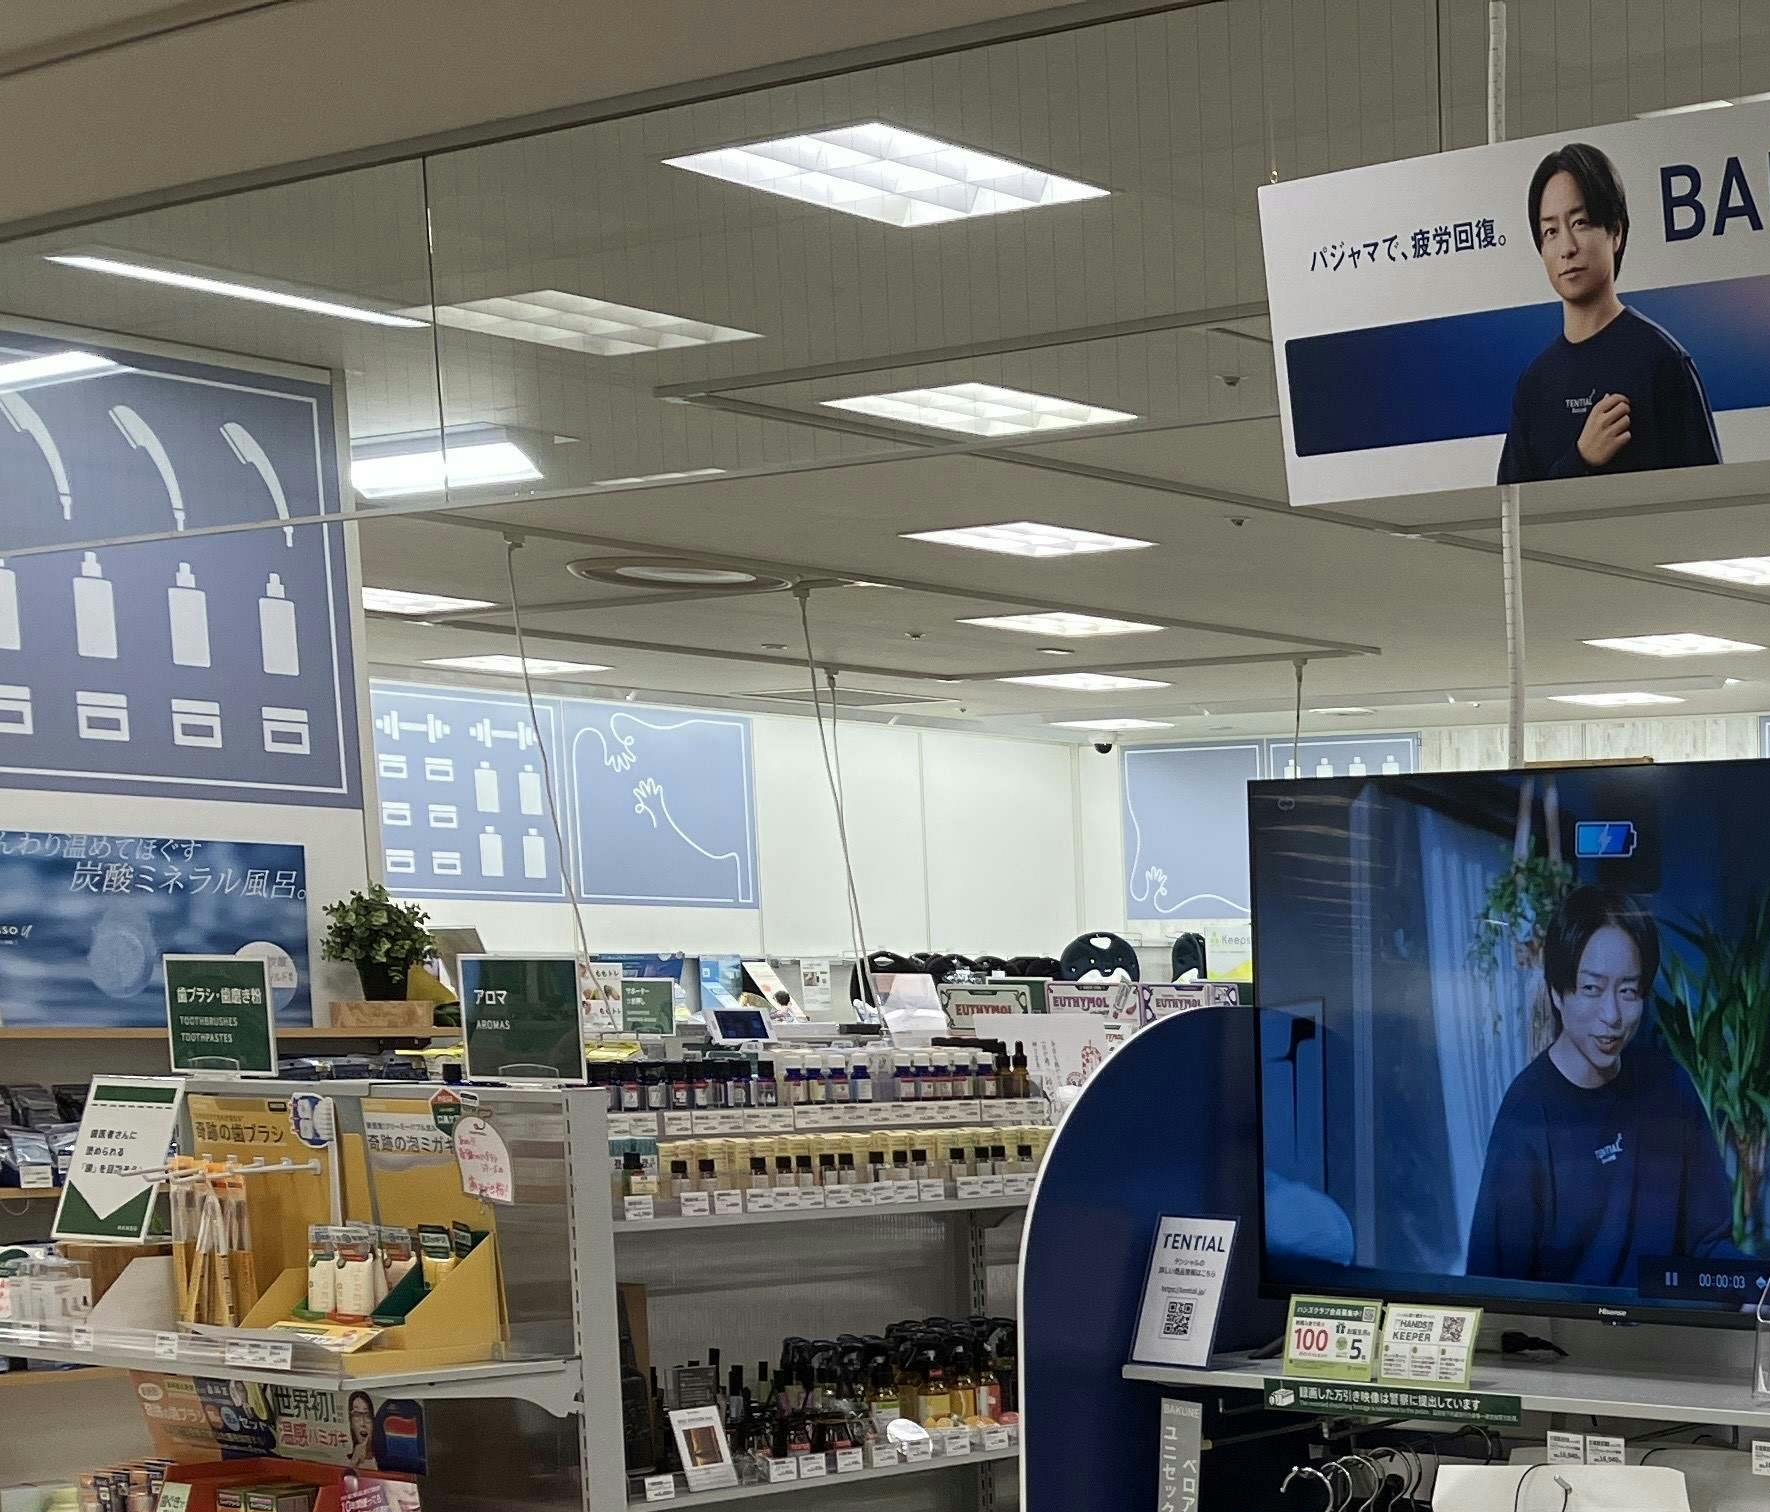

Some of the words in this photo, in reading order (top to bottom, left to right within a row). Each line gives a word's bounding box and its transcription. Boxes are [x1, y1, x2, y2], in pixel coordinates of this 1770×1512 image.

[1309, 218, 1508, 273] パジャマで、疲労回復。
[69, 861, 306, 900] 炭酸ミネラル風呂。
[176, 987, 262, 1005] 歯ブラシ・歯磨き粉
[473, 990, 508, 1006] アロマ
[1053, 995, 1108, 1011] EUTHYMOL
[180, 1016, 238, 1026] TOOTHBRUSHES
[475, 1019, 511, 1031] AROMAS
[181, 1033, 233, 1043] TOOTHPASTES
[195, 1122, 284, 1143] 奇跡の歯ブラシ
[1162, 1233, 1225, 1253] TENTIAL
[1699, 1273, 1746, 1289] 00:00:03
[1294, 1328, 1329, 1352] 100
[1392, 1331, 1431, 1342] KEEPER
[275, 1387, 335, 1423] 世界初!
[1299, 1386, 1481, 1411] 録画した万引き映像は警察に提出しています
[1181, 1459, 1198, 1512] ベロア
